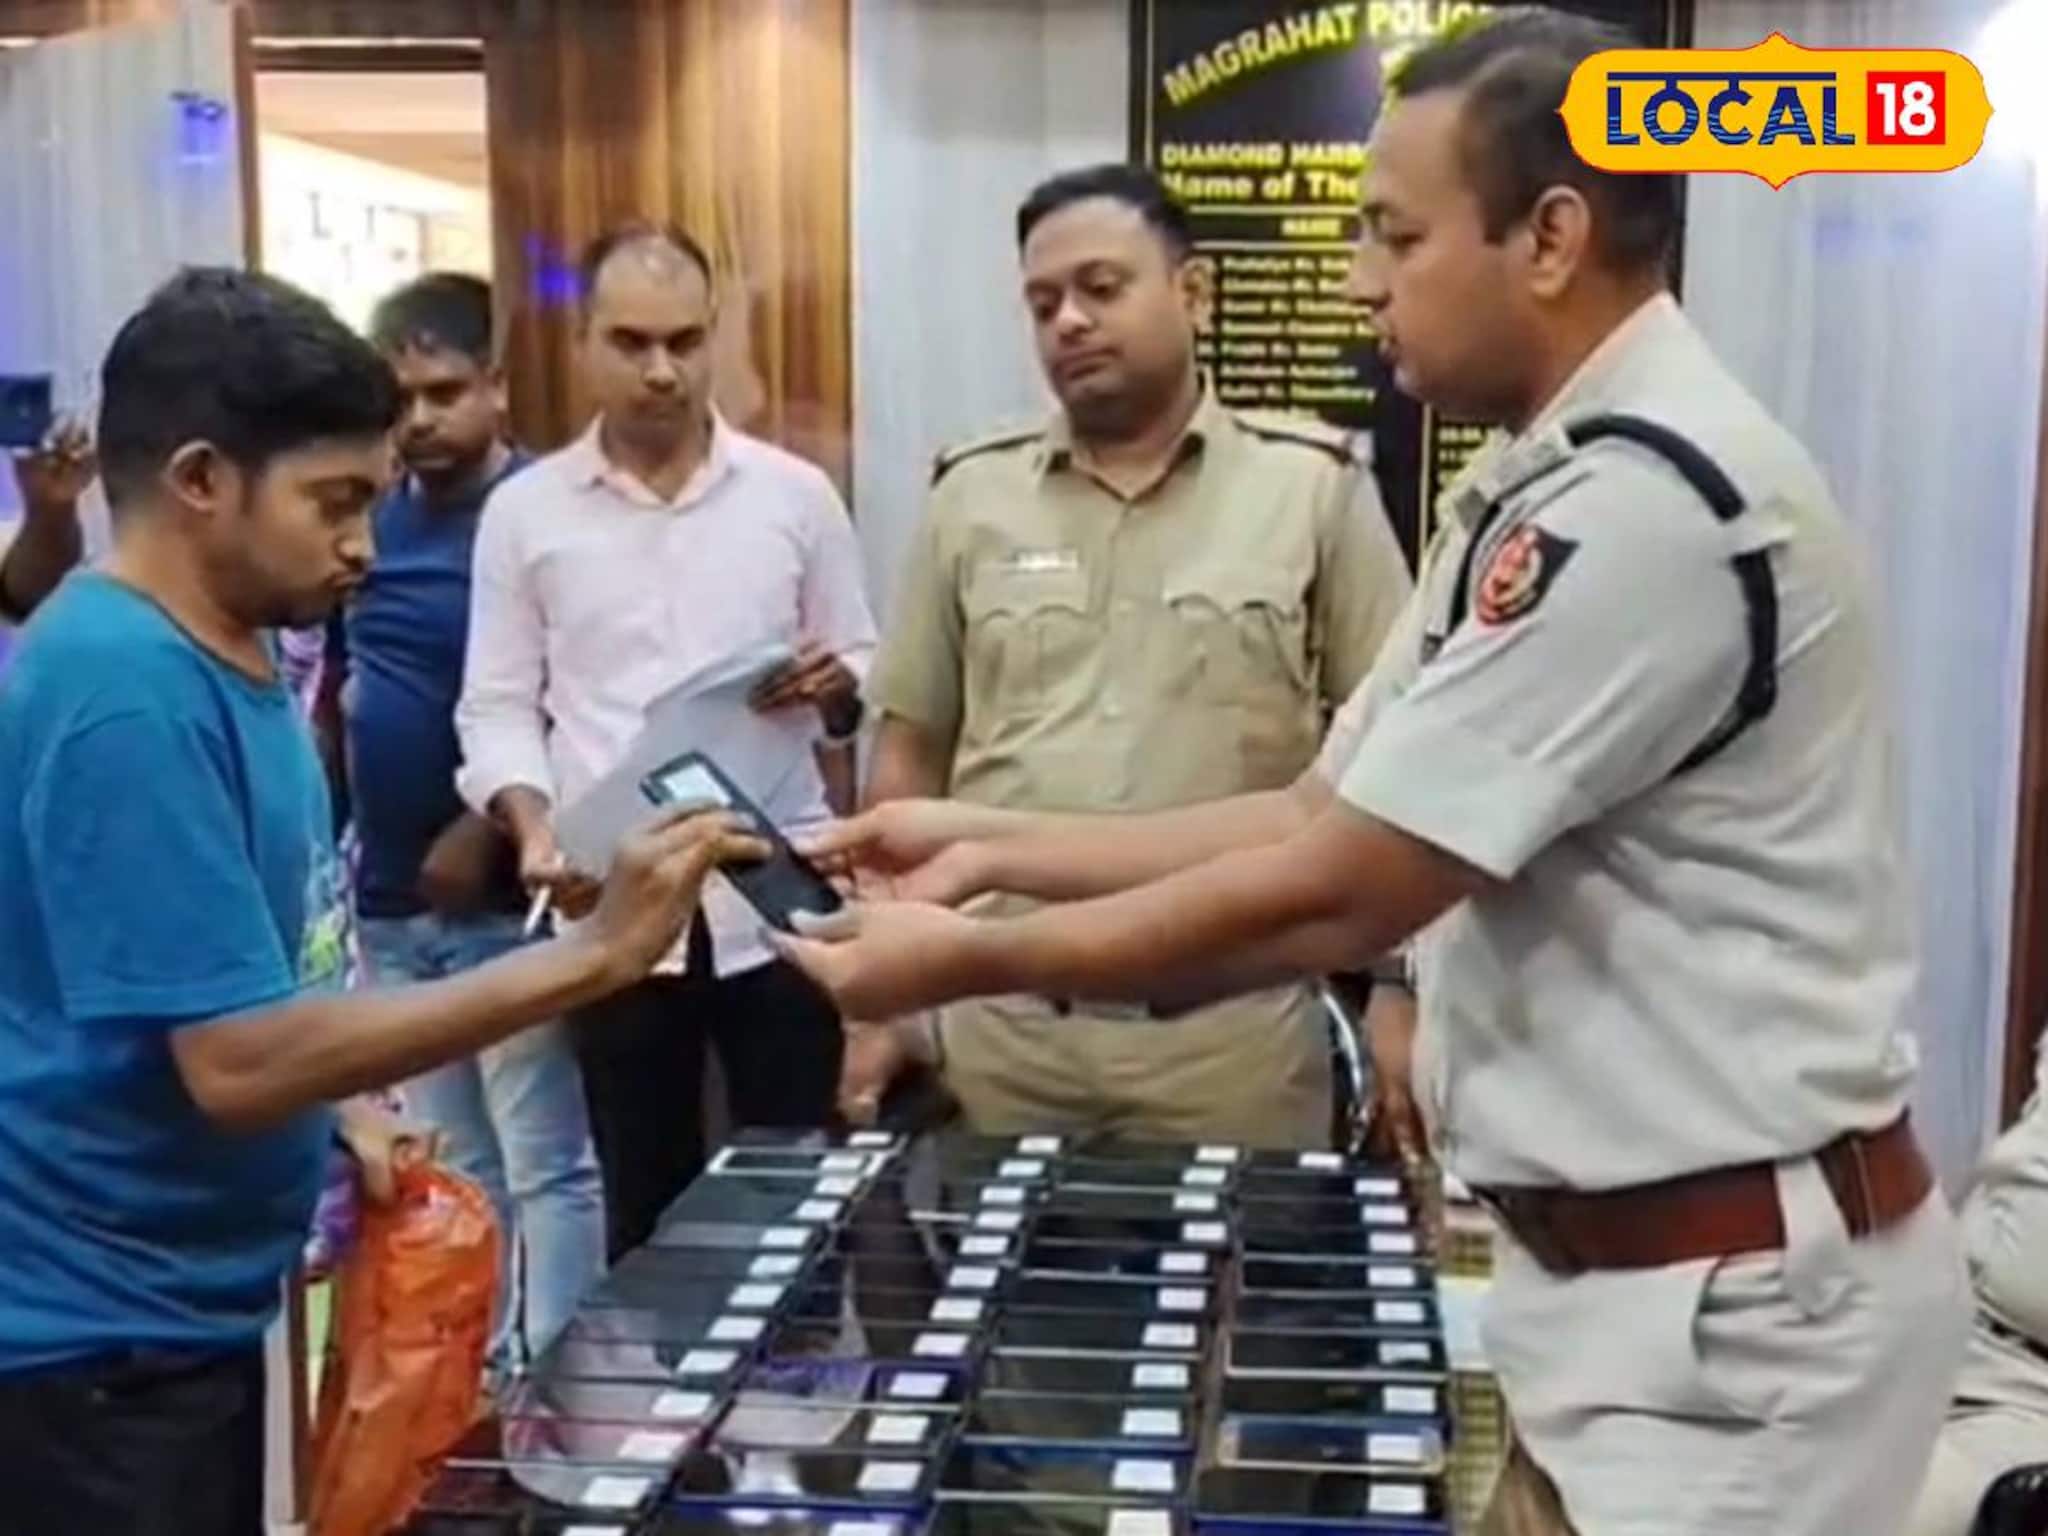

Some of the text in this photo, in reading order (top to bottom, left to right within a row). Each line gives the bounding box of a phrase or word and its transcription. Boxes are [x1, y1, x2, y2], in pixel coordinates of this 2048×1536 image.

[1162, 4, 1357, 105] MAGRAHAT
[1161, 142, 1285, 168] DIAMOND
[1162, 171, 1255, 199] Name
[1261, 170, 1296, 199] of
